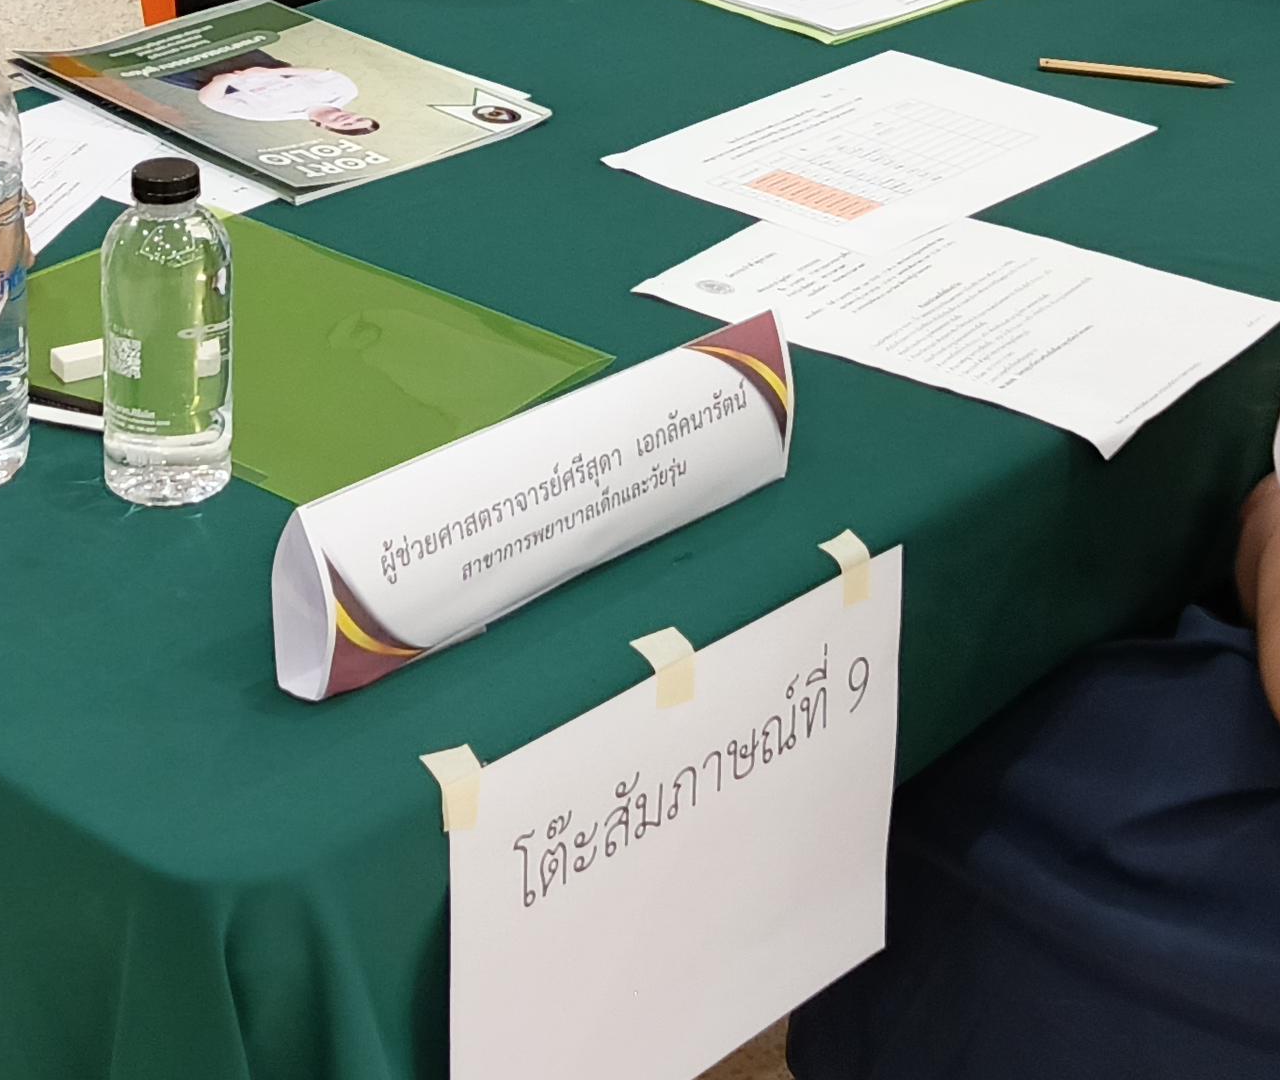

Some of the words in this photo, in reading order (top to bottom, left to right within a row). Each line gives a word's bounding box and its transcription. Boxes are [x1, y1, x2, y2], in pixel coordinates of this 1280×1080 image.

[258, 138, 363, 166] FOLIO
[295, 150, 391, 178] PORT
[380, 446, 623, 585] ผู้ช่วยศาสตราจารย์ศรีสุดา
[636, 378, 748, 458] เอกลัคนารัตน์
[461, 458, 688, 581] สาขาการพยาบาลเด็กและวัยรุ่น
[513, 643, 829, 908] โต๊ะสัมภาษณ์ที่
[847, 655, 871, 713] 9
